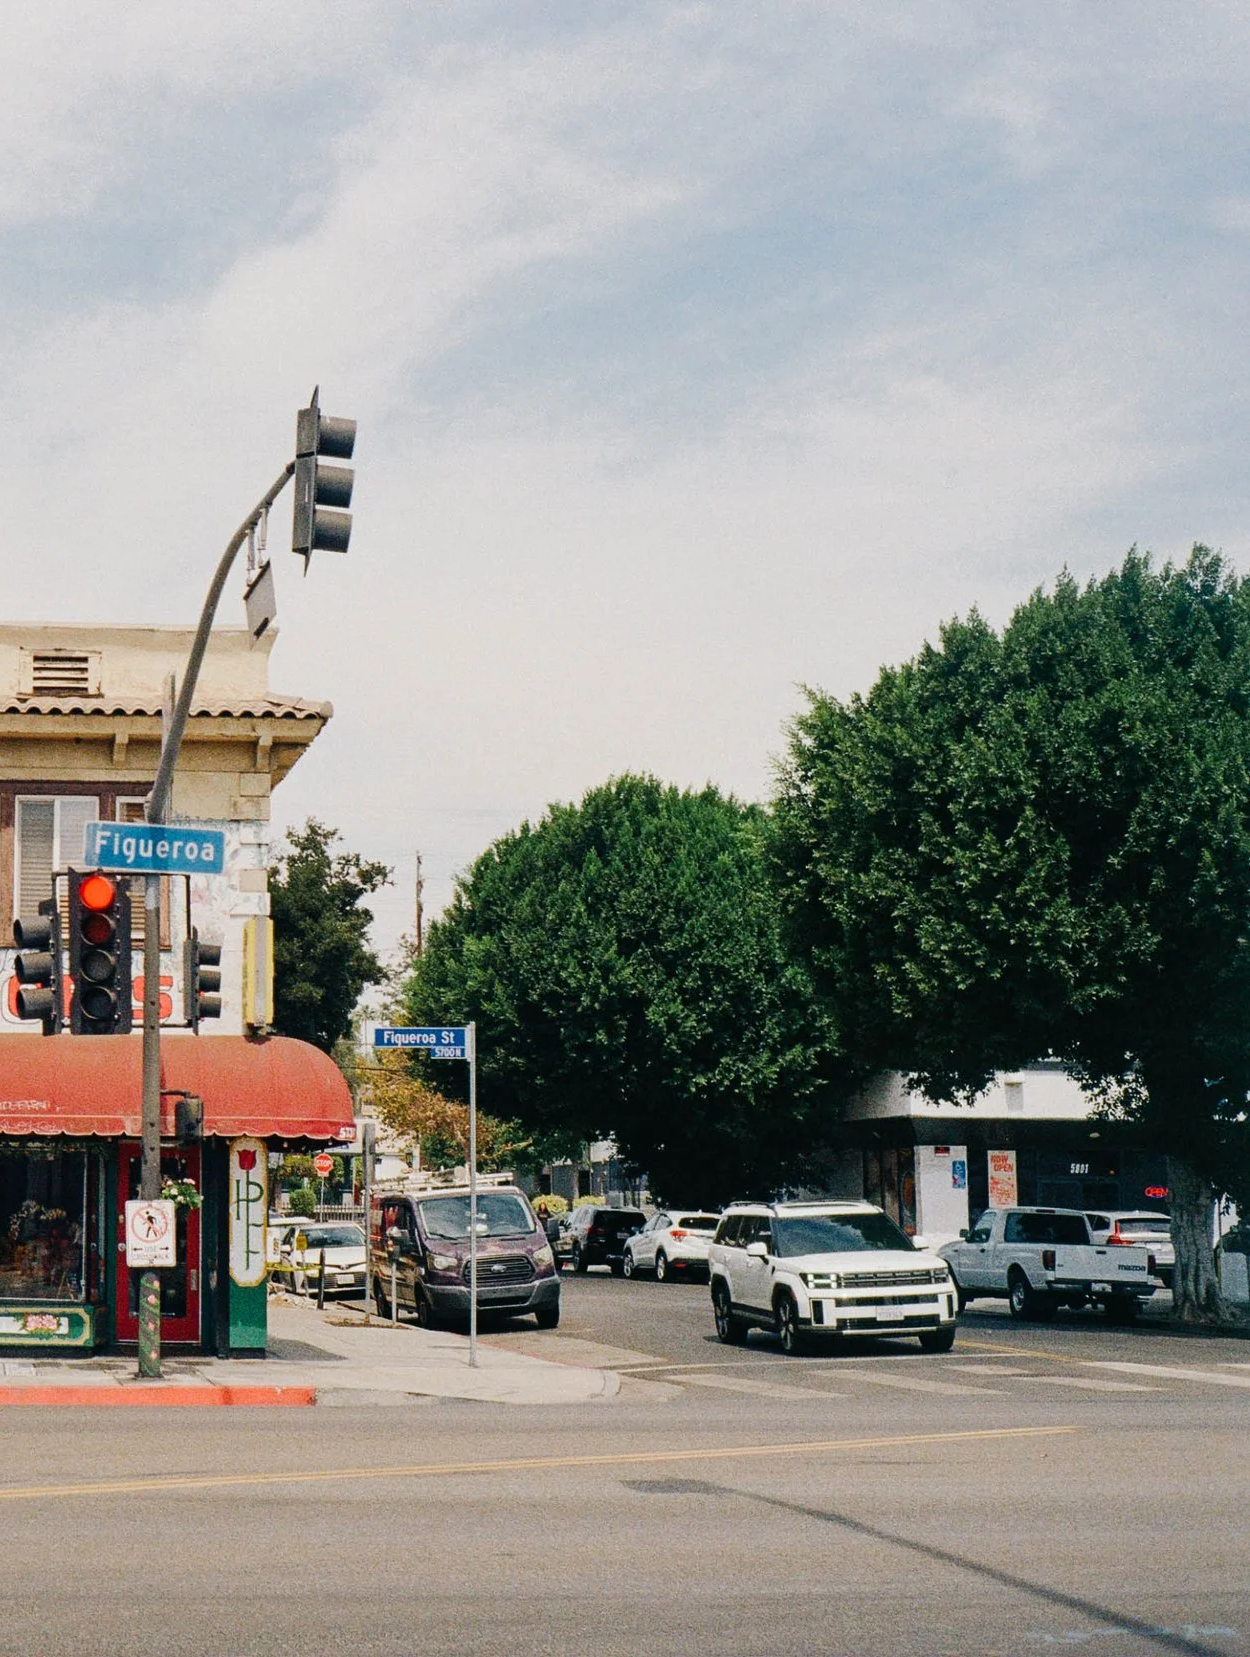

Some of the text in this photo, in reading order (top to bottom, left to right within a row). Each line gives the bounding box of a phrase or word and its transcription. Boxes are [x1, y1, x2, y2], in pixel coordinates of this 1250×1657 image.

[94, 830, 215, 864] Figueroa
[383, 1030, 455, 1046] Figueroa St
[994, 1163, 1014, 1172] OPEN
[1070, 1163, 1090, 1174] 5801
[1144, 1186, 1169, 1197] OPEN
[1117, 1264, 1147, 1272] mazda
